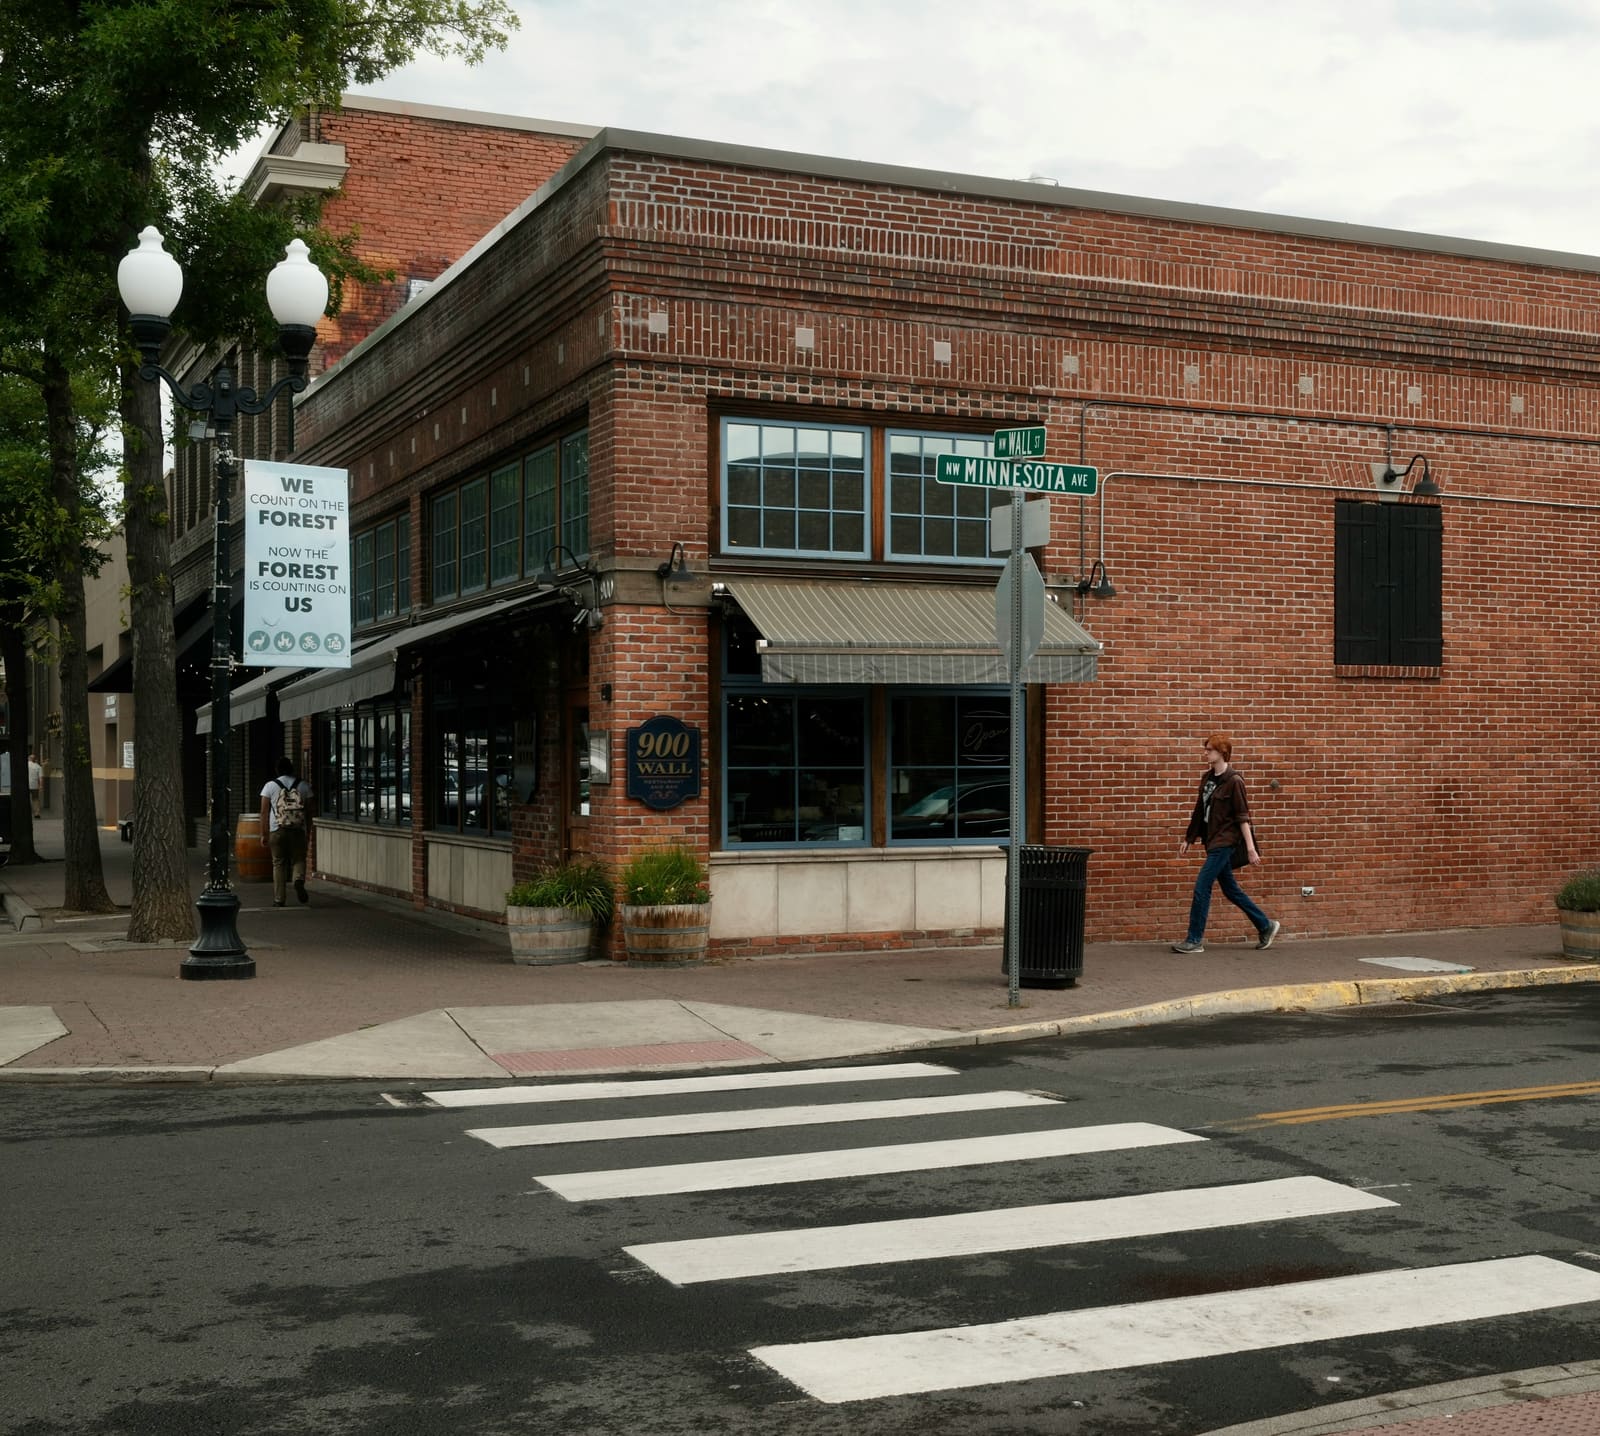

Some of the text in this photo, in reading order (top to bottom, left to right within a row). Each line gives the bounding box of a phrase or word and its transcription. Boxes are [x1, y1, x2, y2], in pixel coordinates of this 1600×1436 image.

[998, 431, 1041, 456] NW WALL ST
[945, 458, 1089, 491] NW MINNESOTA AVE
[280, 477, 314, 494] WE
[250, 494, 345, 512] COUNT ON THE
[258, 510, 338, 530] FOREST
[268, 546, 329, 560] NOW THE
[258, 561, 339, 580] FOREST
[249, 580, 347, 594] IS COUNTING ON
[284, 597, 313, 613] US
[636, 732, 690, 758] 900
[636, 762, 693, 775] WALL
